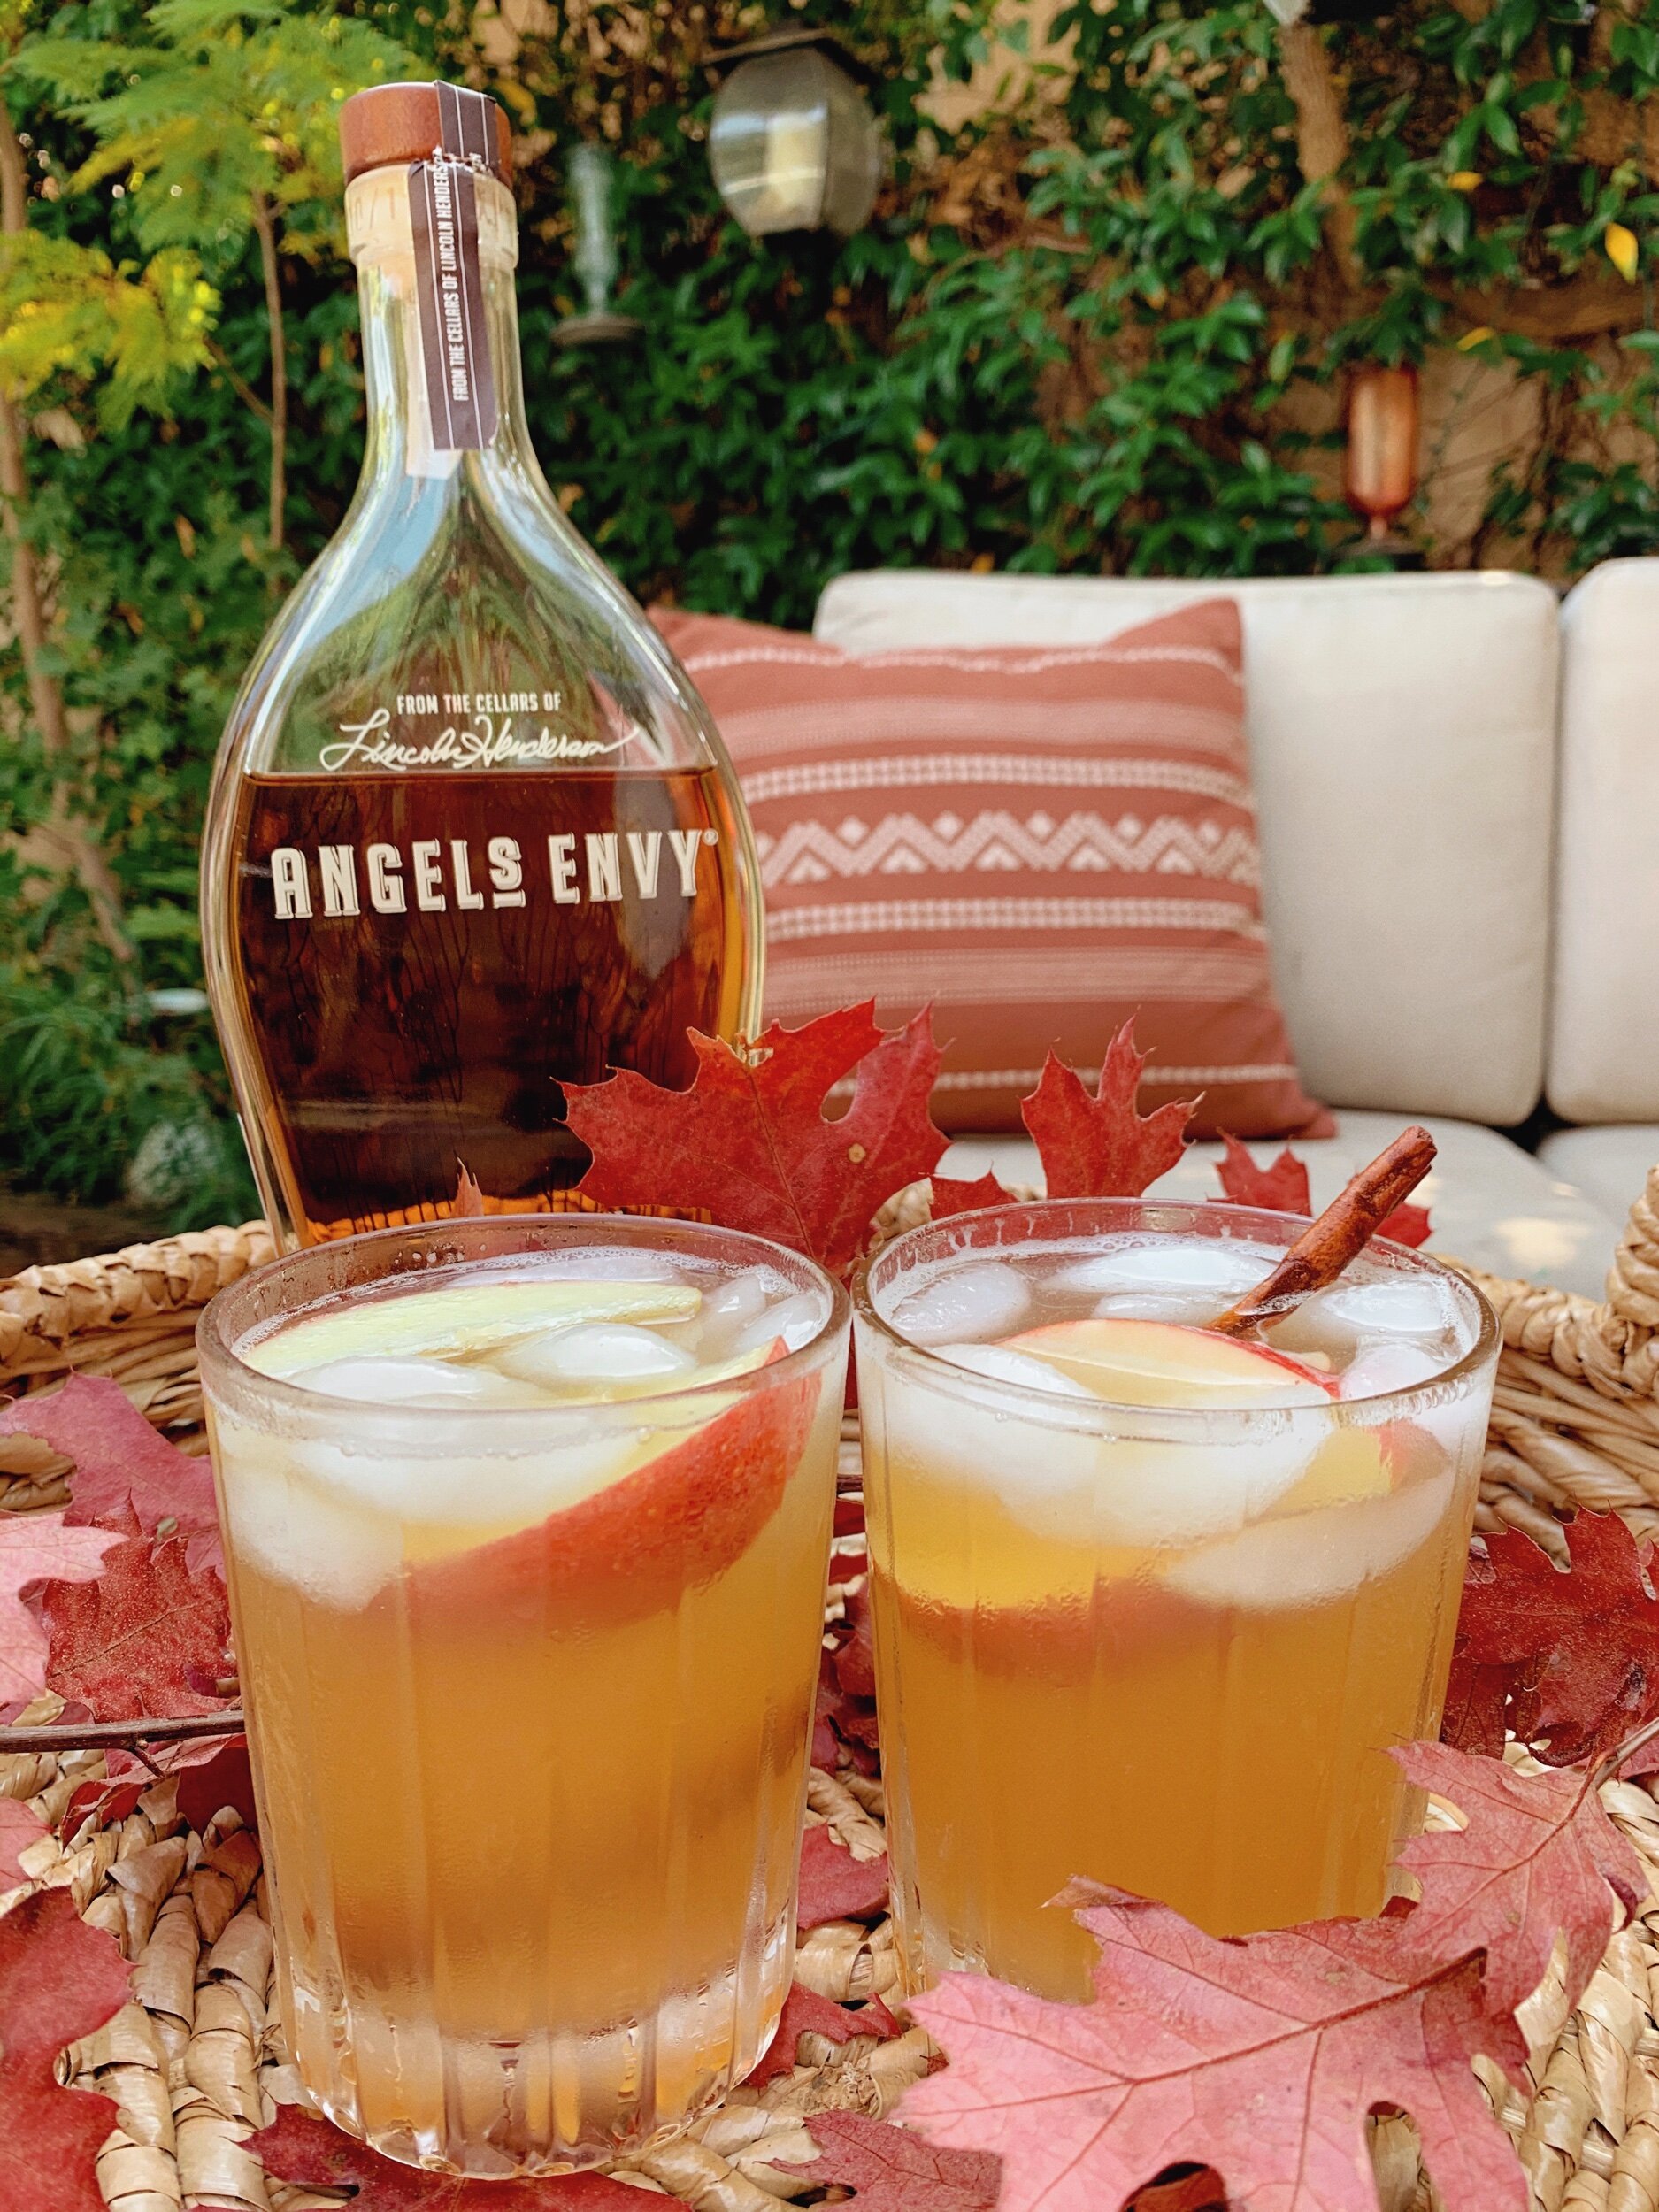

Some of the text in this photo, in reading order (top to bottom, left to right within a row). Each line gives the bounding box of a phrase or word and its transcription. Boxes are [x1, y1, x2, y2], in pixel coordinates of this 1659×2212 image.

[437, 221, 457, 271] LINCOLN
[441, 273, 458, 290] OF
[443, 292, 463, 342] CELLARS
[448, 343, 465, 366] THE
[450, 367, 469, 401] FROM
[396, 691, 562, 715] FROM THE CELLARS OF
[319, 708, 641, 772] Lincoln Henderson
[270, 836, 526, 920] ANGELS
